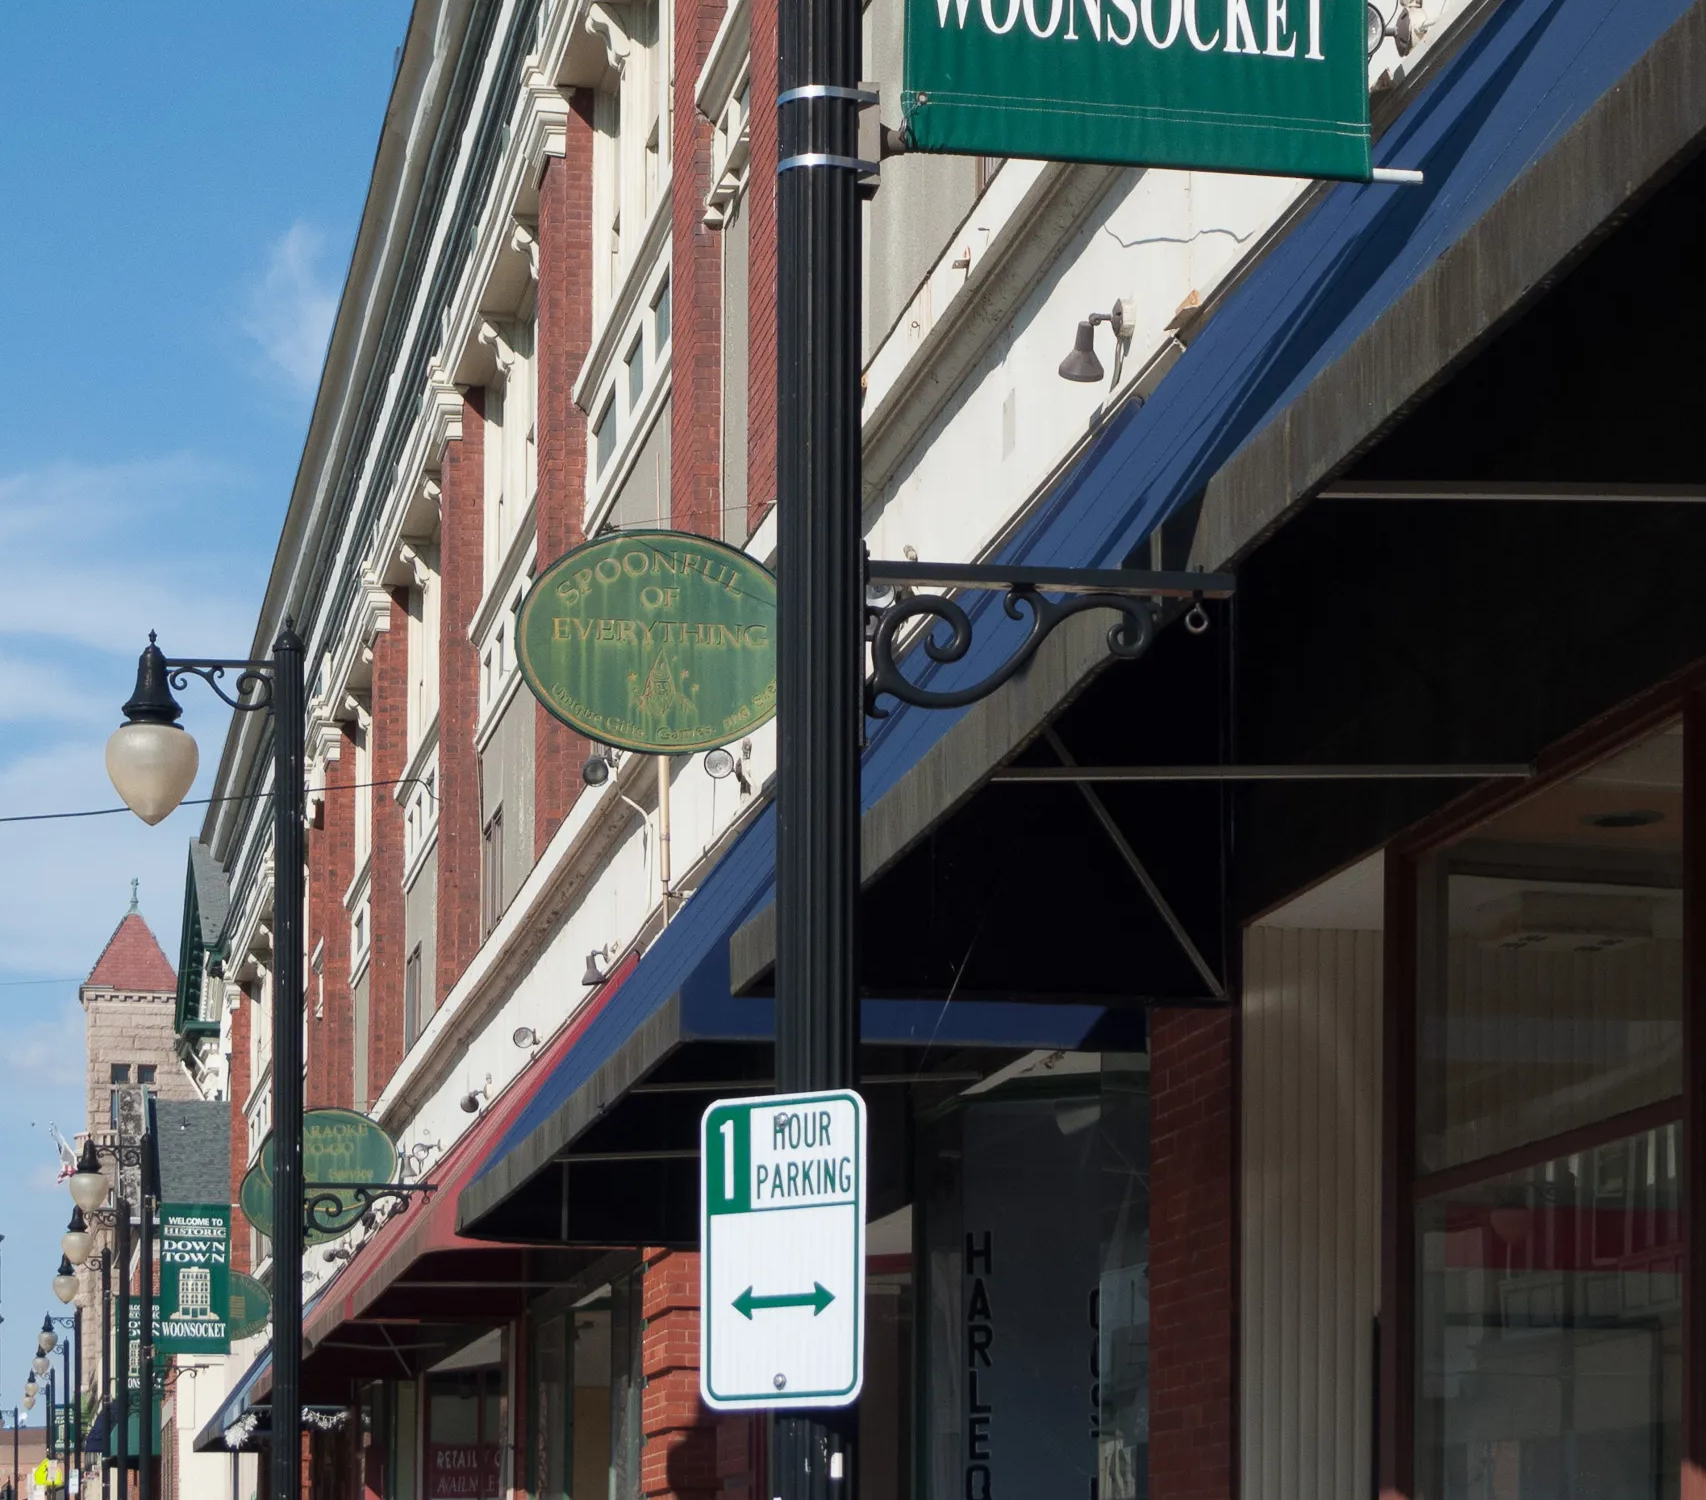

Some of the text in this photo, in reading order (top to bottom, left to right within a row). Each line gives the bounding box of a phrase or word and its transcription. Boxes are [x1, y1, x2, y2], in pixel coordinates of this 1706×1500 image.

[557, 550, 742, 605] SPOONFUL
[640, 585, 680, 610] OF
[552, 616, 768, 647] EVERYTHING
[773, 1110, 831, 1150] HOUR
[719, 1119, 735, 1200] 1
[756, 1156, 851, 1200] PARKING
[164, 1226, 226, 1237] HISTORIC
[169, 1217, 223, 1227] WELCOME TO
[162, 1252, 225, 1264] TOWN
[163, 1240, 226, 1252] DOWN
[162, 1321, 226, 1338] WOONSOCKET
